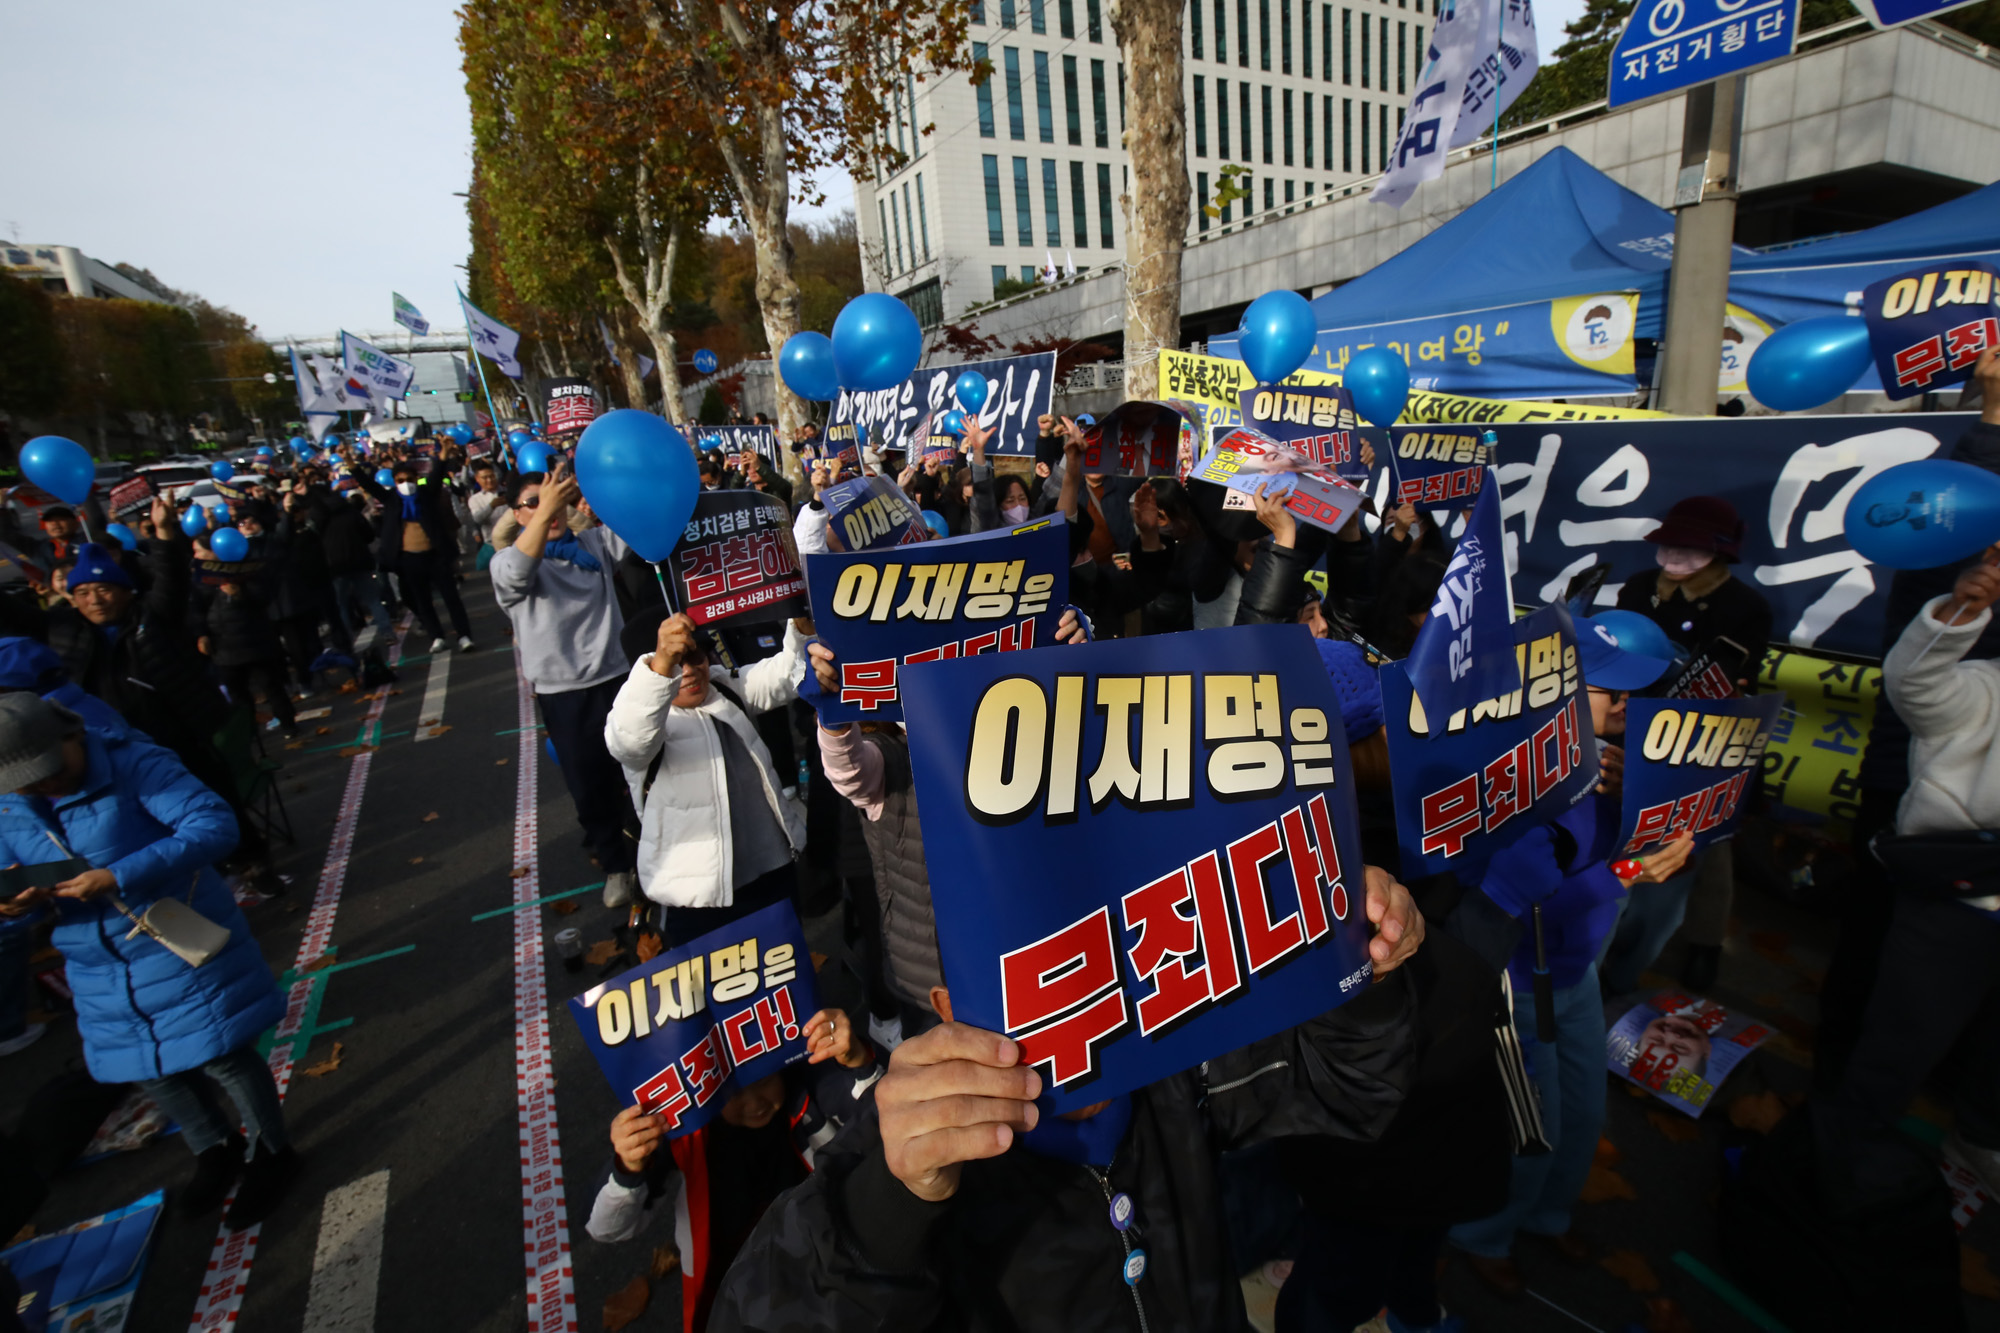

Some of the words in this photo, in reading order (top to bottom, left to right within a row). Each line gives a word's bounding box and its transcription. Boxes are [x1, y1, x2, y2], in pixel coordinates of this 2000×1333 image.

[1167, 356, 1241, 404] 검찰총장님
[927, 364, 1041, 454] 무다!
[1252, 391, 1355, 430] 이재명은
[1285, 431, 1352, 467] 죄다!
[1397, 432, 1488, 466] 이재명은
[1396, 465, 1483, 504] 무죄다!
[684, 508, 751, 543] 정치검찰
[843, 493, 914, 551] 이재명은
[705, 599, 735, 619] 김건희
[737, 588, 774, 609] 수사검사
[775, 583, 791, 598] 전원
[832, 559, 1055, 623] 이재명은
[967, 673, 1335, 816] 이재명은
[1642, 709, 1769, 768] 이재명은
[1421, 695, 1582, 859] 무죄다!
[1622, 769, 1750, 853] 무죄다!
[1000, 792, 1350, 1089] 무죄다!
[595, 937, 797, 1046] 이재명은
[632, 984, 801, 1130] 무죄다!
[527, 1081, 546, 1122] 안전제일
[530, 1123, 551, 1169] DANGER!
[532, 1169, 553, 1195] 위험
[219, 1228, 250, 1273] NGER!
[535, 1210, 559, 1267] 안전제일
[208, 1274, 238, 1307] 위험
[539, 1268, 564, 1333] DANGER!
